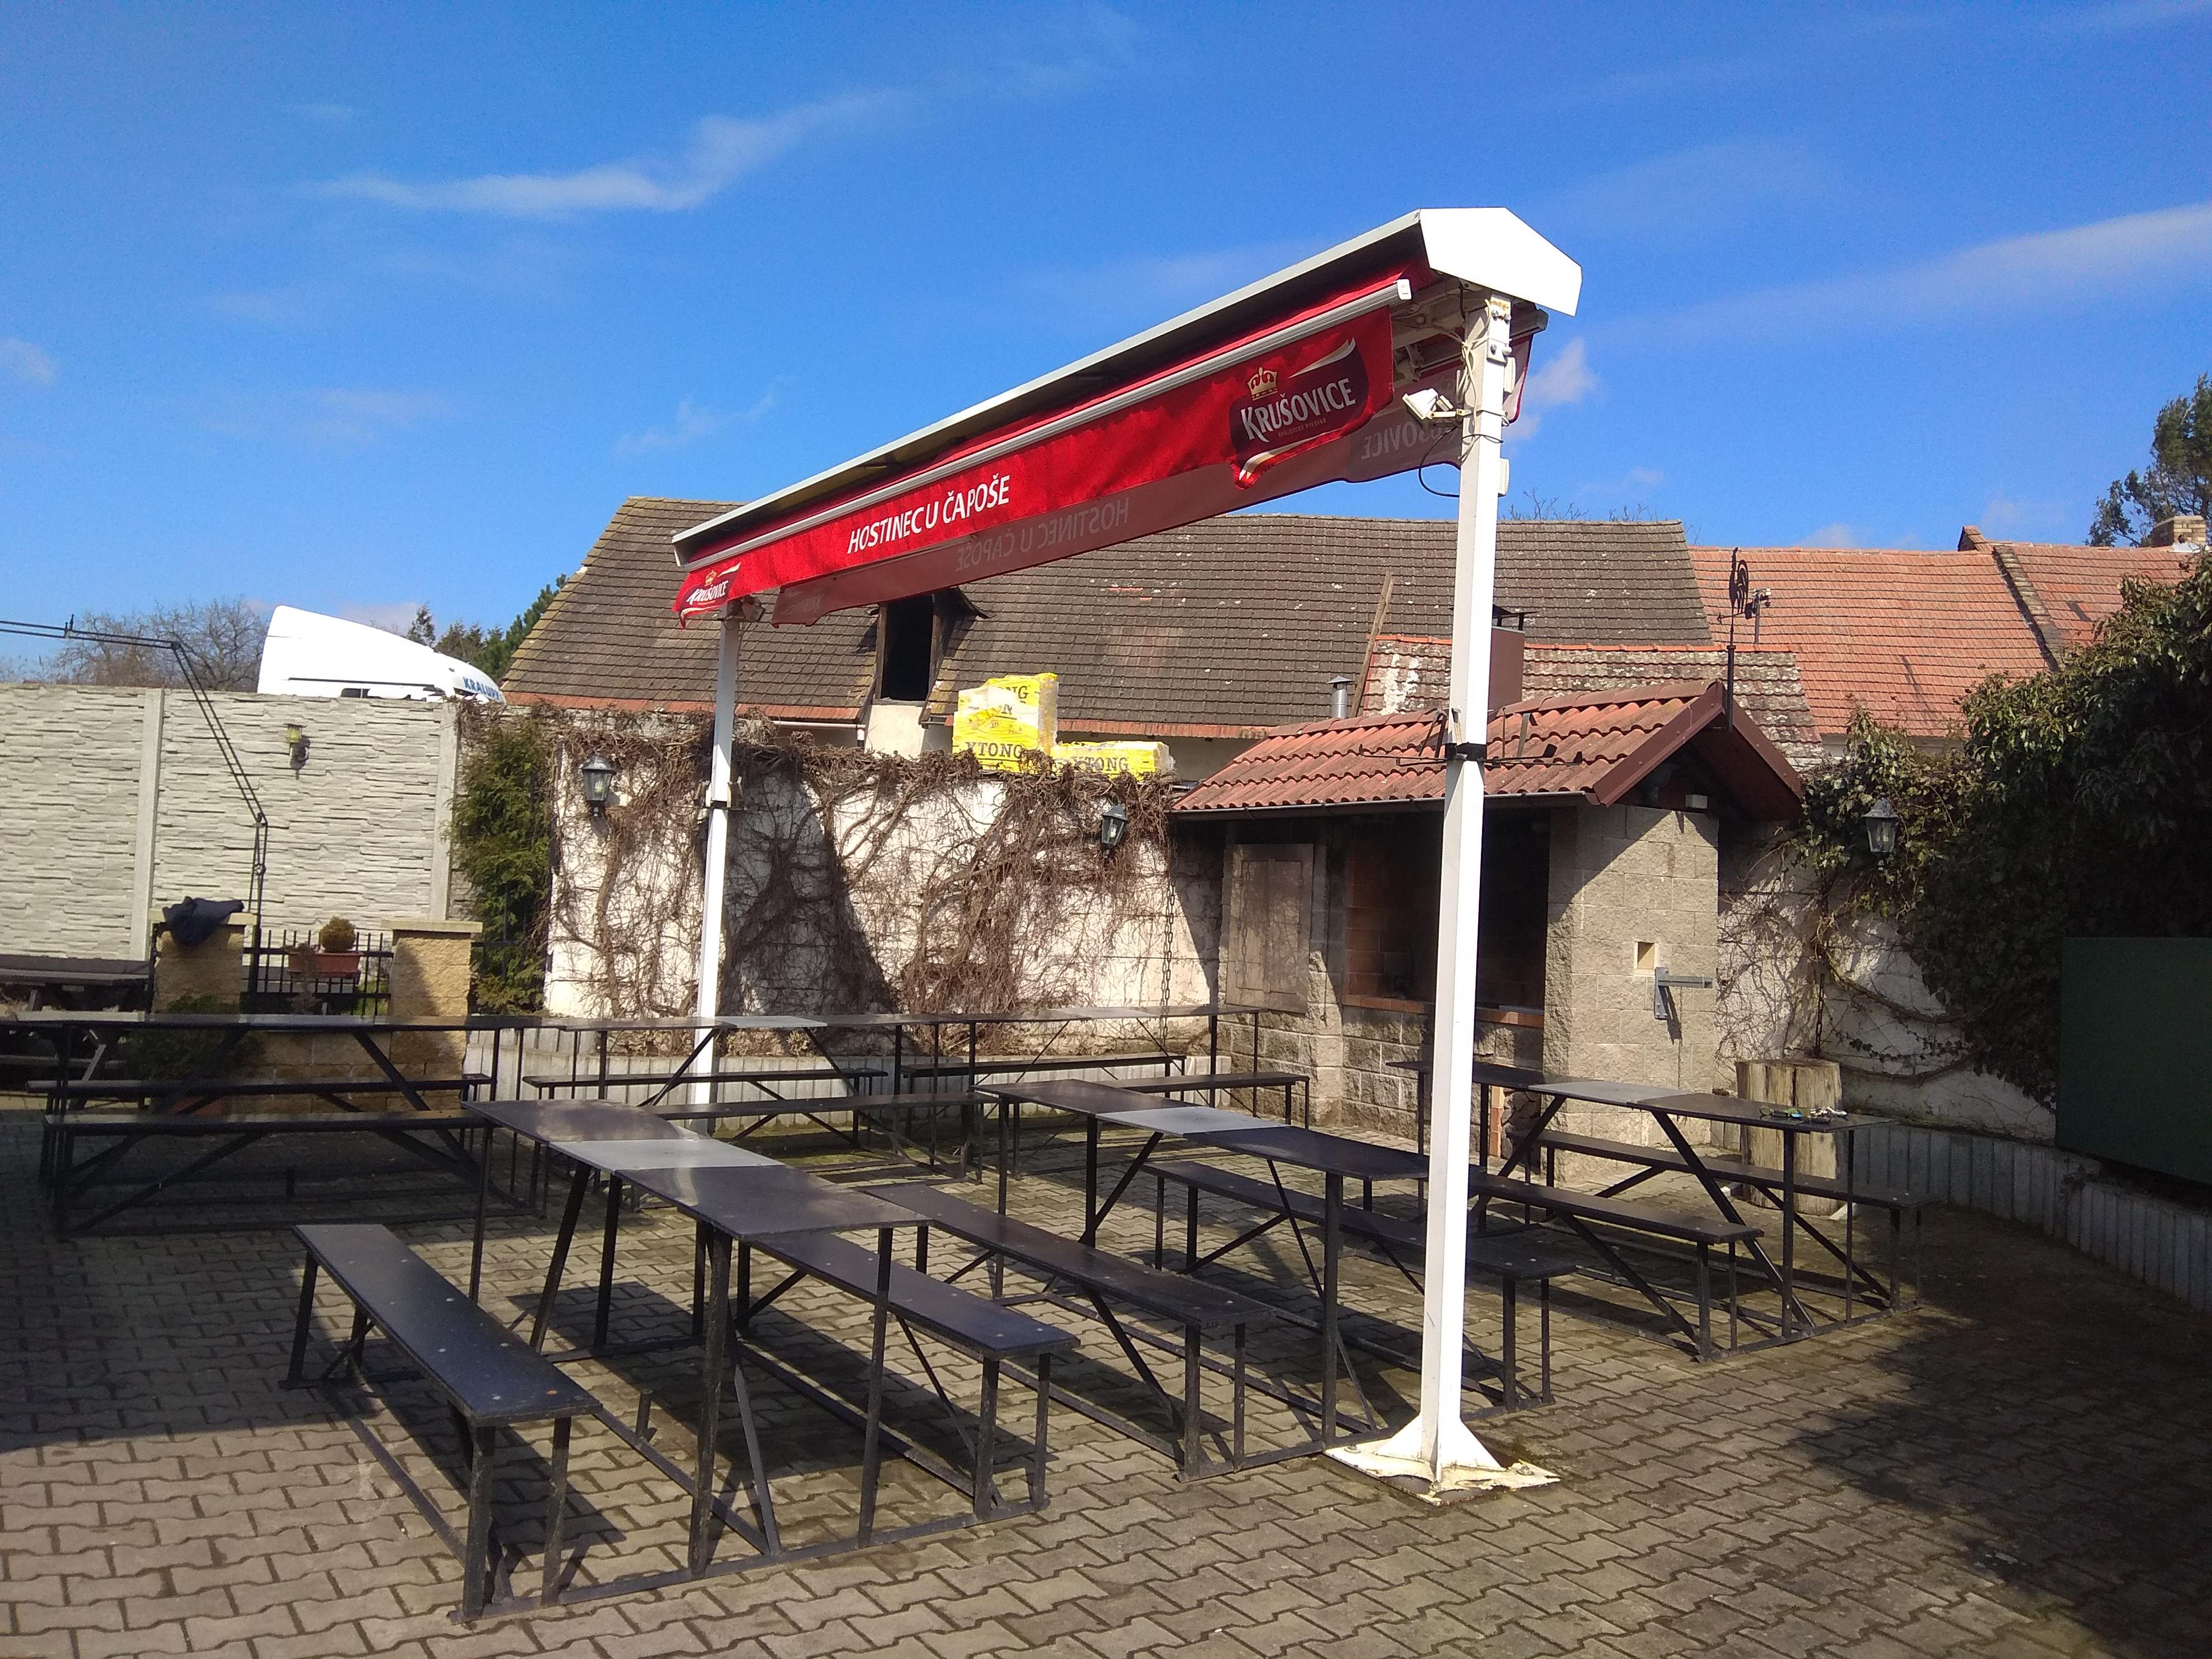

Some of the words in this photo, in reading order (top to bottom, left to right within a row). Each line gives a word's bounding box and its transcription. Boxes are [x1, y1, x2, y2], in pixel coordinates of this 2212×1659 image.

[1241, 378, 1356, 442] KRUŠOVICE
[847, 507, 924, 554] HOSTINEC
[925, 501, 939, 529] U
[942, 473, 1010, 524] ČAPOŠE
